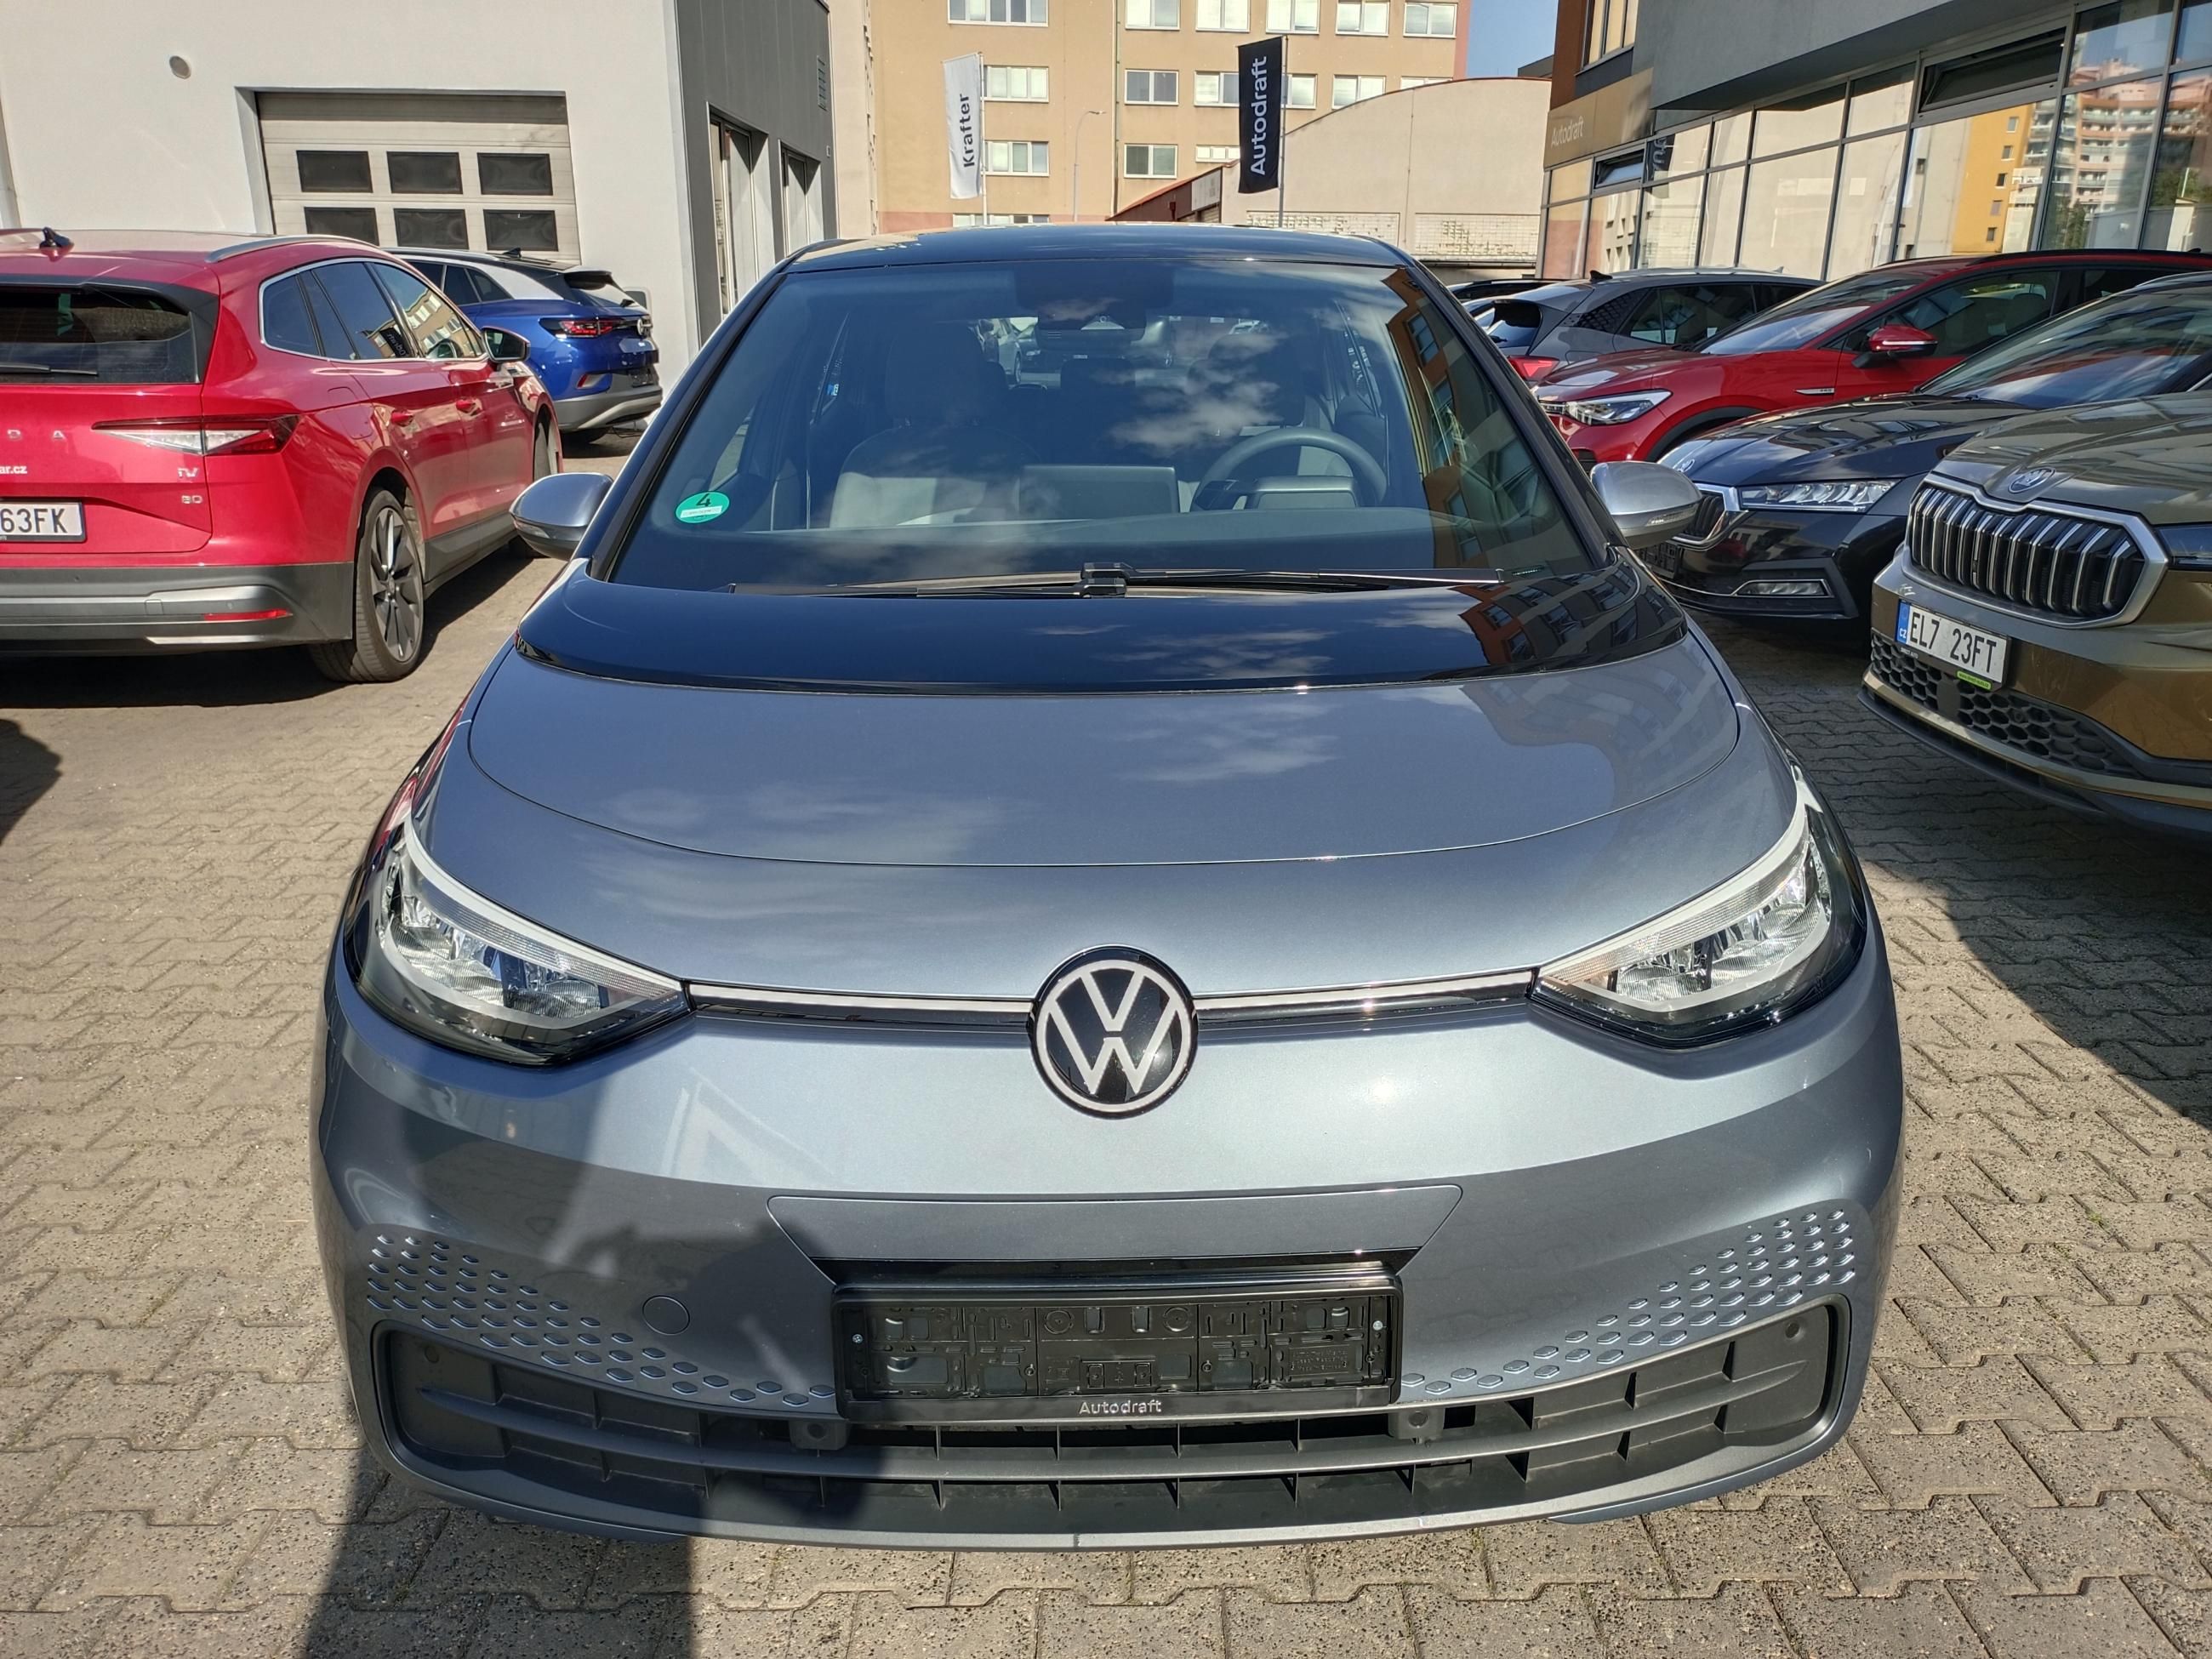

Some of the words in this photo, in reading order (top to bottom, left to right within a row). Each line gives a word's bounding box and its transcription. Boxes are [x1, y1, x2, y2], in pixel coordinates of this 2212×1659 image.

[959, 93, 976, 168] Krafter
[1250, 55, 1268, 175] Autodraft
[1550, 115, 1585, 148] Autodraft
[695, 493, 712, 507] 4
[0, 508, 68, 533] 63FK
[1909, 612, 1940, 649] EL7
[1949, 628, 1997, 673] 23FT
[1079, 1399, 1162, 1415] Autodraft
